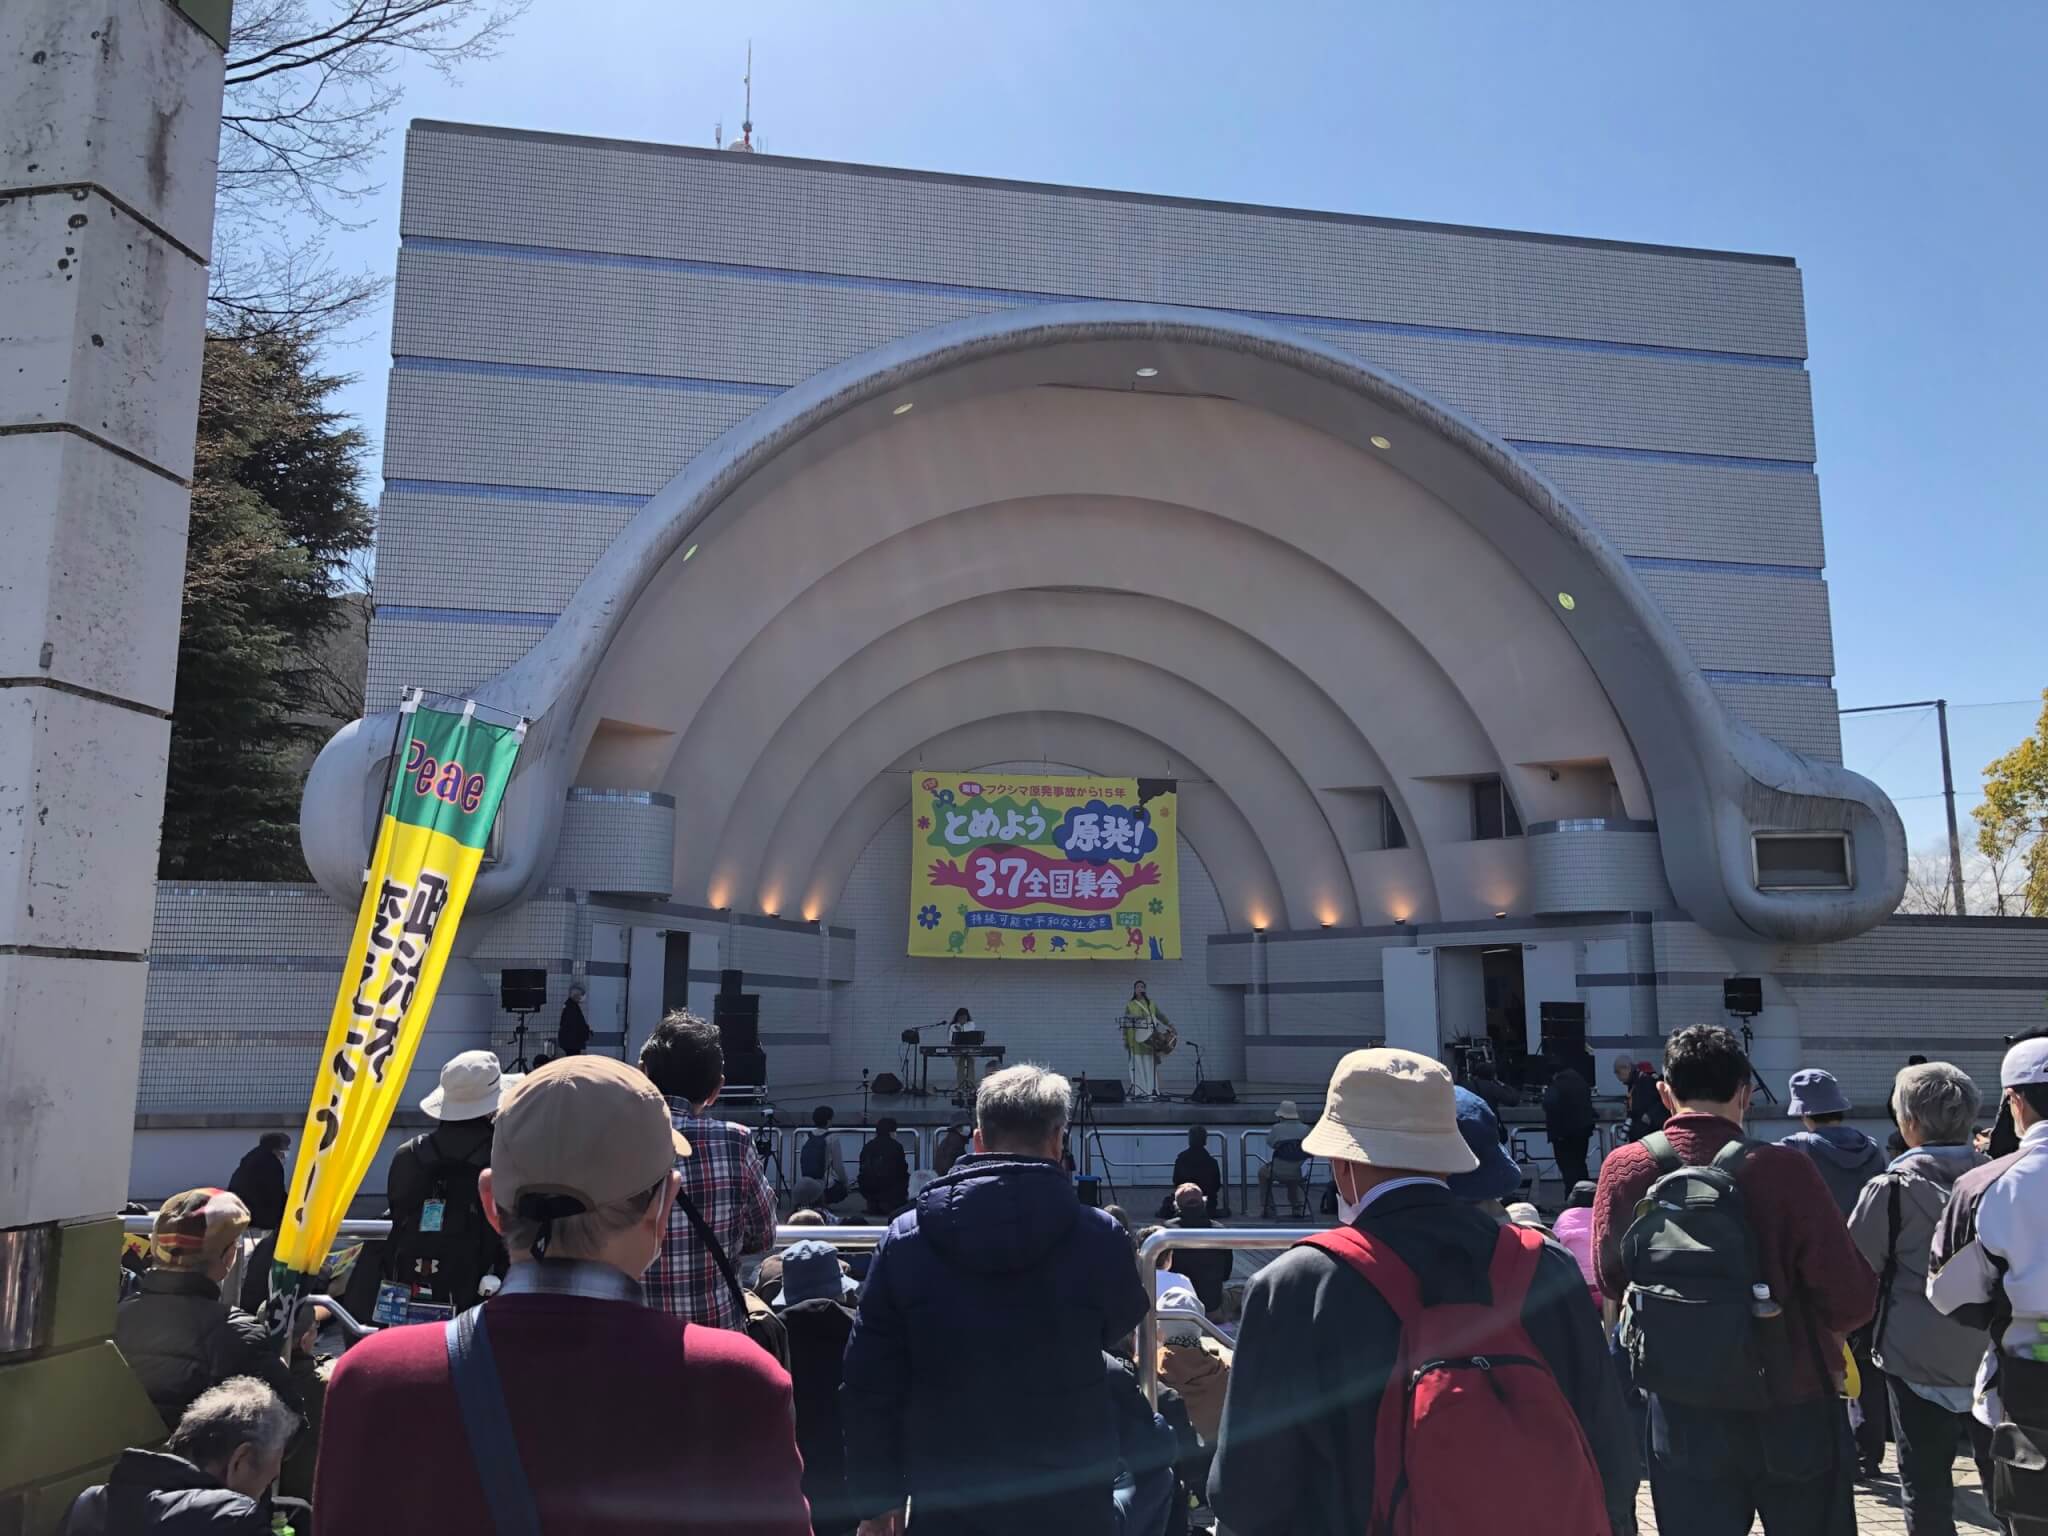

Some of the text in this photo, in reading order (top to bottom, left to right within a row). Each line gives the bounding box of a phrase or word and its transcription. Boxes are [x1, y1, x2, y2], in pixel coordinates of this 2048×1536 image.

[986, 783, 1127, 800] フクシマ原発事故から15年
[943, 805, 1145, 855] とめよう 原発!
[975, 856, 1122, 900] 3.7全国集会
